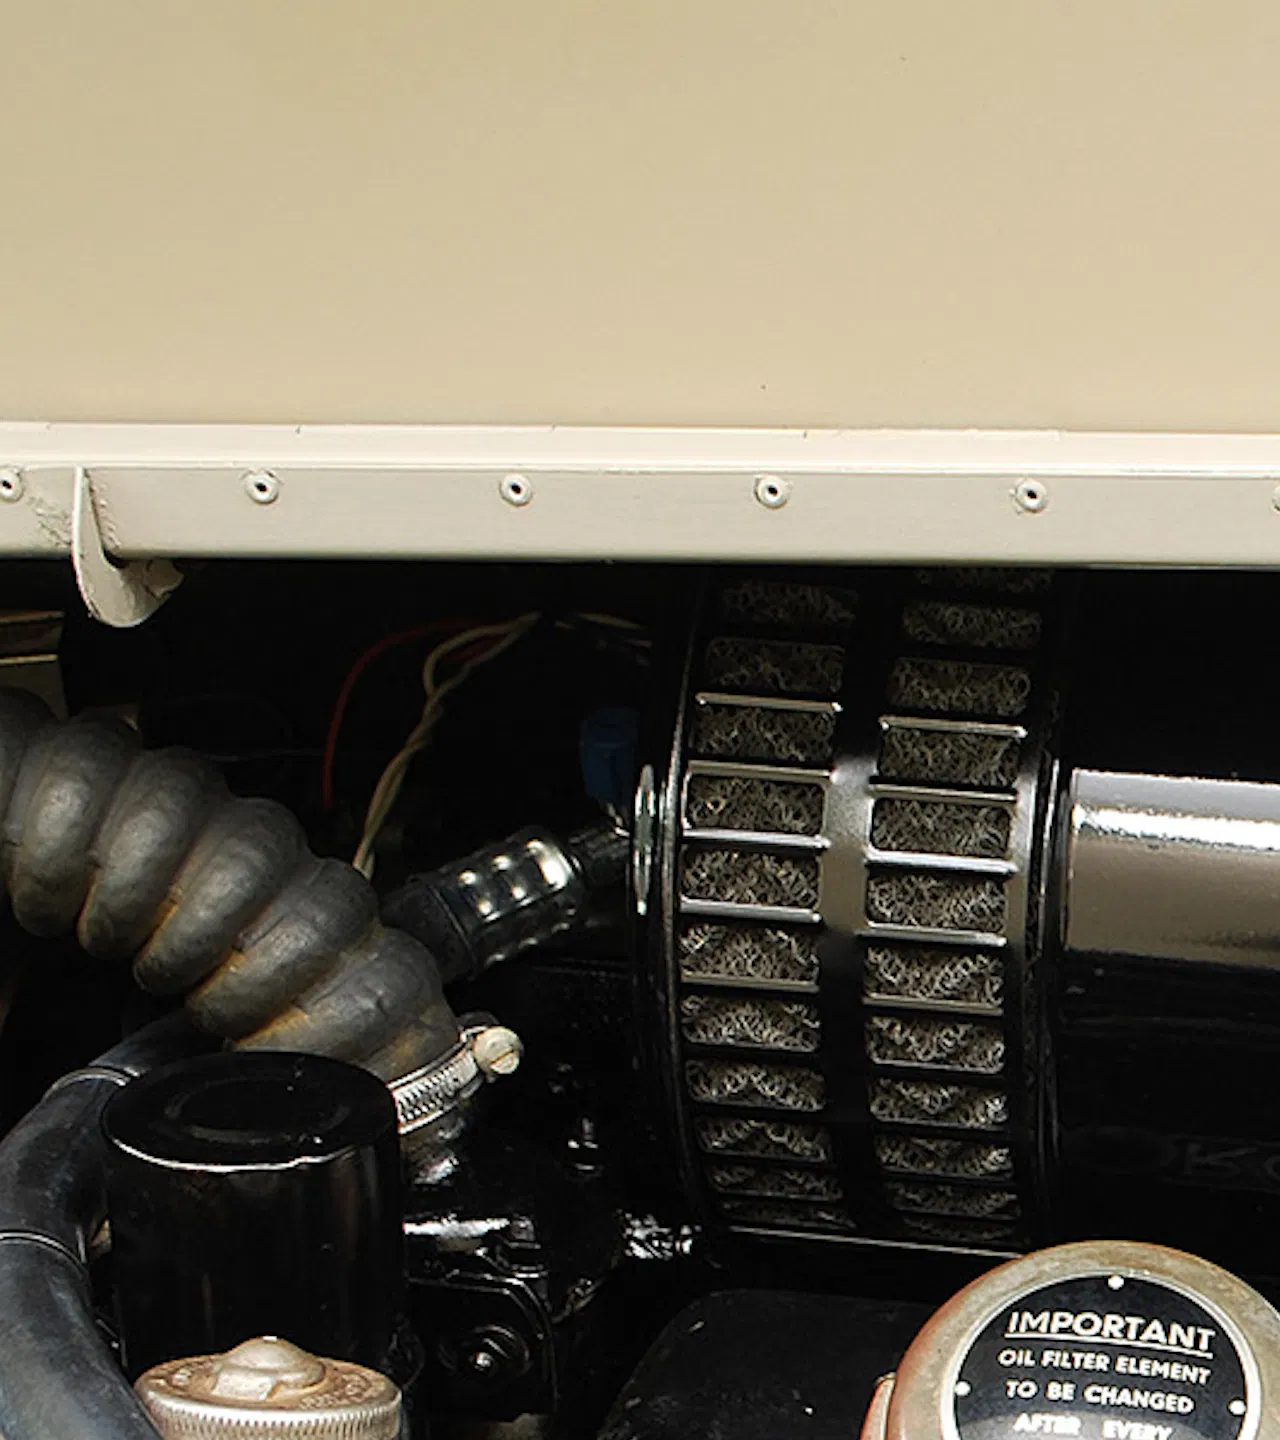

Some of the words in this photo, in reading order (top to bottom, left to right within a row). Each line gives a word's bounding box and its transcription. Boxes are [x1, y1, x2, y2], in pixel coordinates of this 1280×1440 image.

[1007, 1310, 1216, 1351] IMPORTANT
[998, 1349, 1036, 1368] OIL
[1041, 1350, 1110, 1372] FILTER
[1115, 1354, 1211, 1385] ELEMENT
[1006, 1379, 1038, 1399] TO
[1046, 1381, 1076, 1401] BE
[1084, 1384, 1195, 1414] CHANGED
[1013, 1412, 1082, 1436] AFTER
